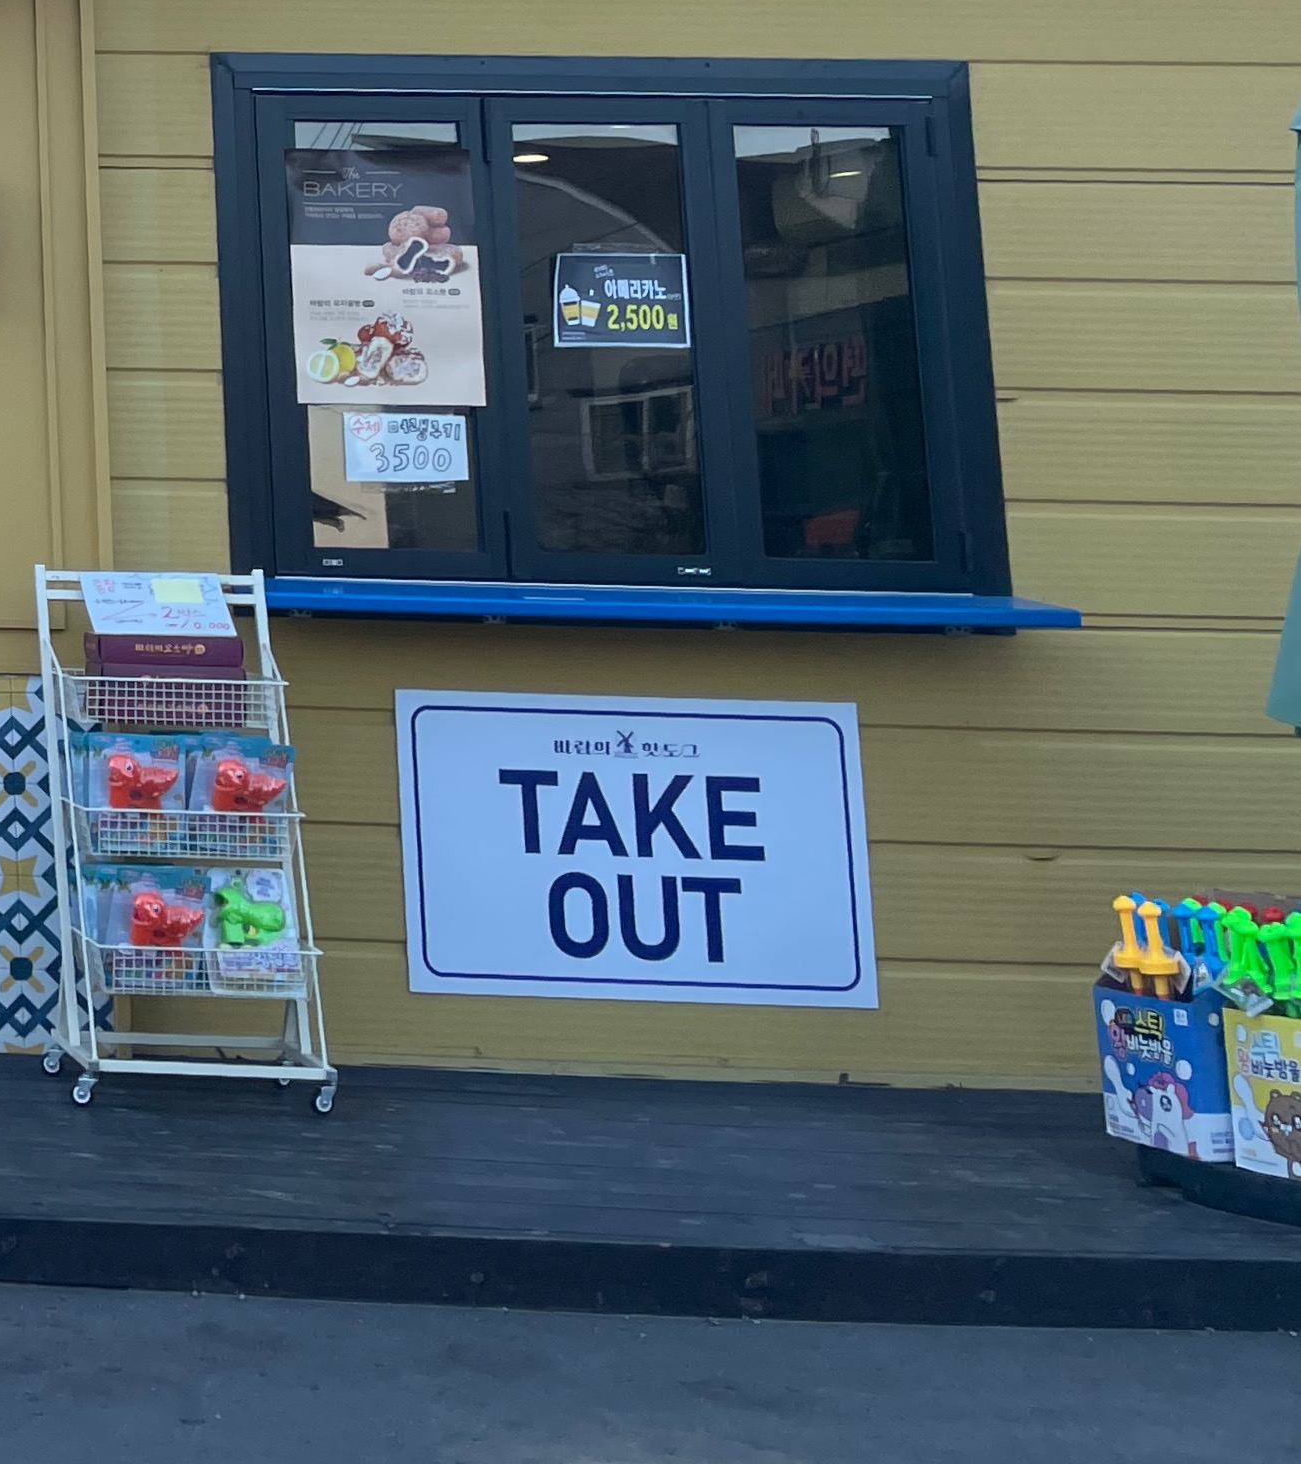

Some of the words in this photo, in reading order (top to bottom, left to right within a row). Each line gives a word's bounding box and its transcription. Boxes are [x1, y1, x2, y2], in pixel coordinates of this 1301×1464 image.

[342, 166, 361, 180] The
[302, 181, 404, 198] BAKERY
[604, 279, 667, 299] 아메리카노
[352, 418, 381, 434] 수제
[370, 443, 452, 473] 3500
[554, 739, 611, 756] 바람의
[641, 742, 702, 758] 핫도그
[498, 767, 767, 862] TAKE
[548, 871, 743, 963] OUT
[1134, 1008, 1165, 1041] 스틱
